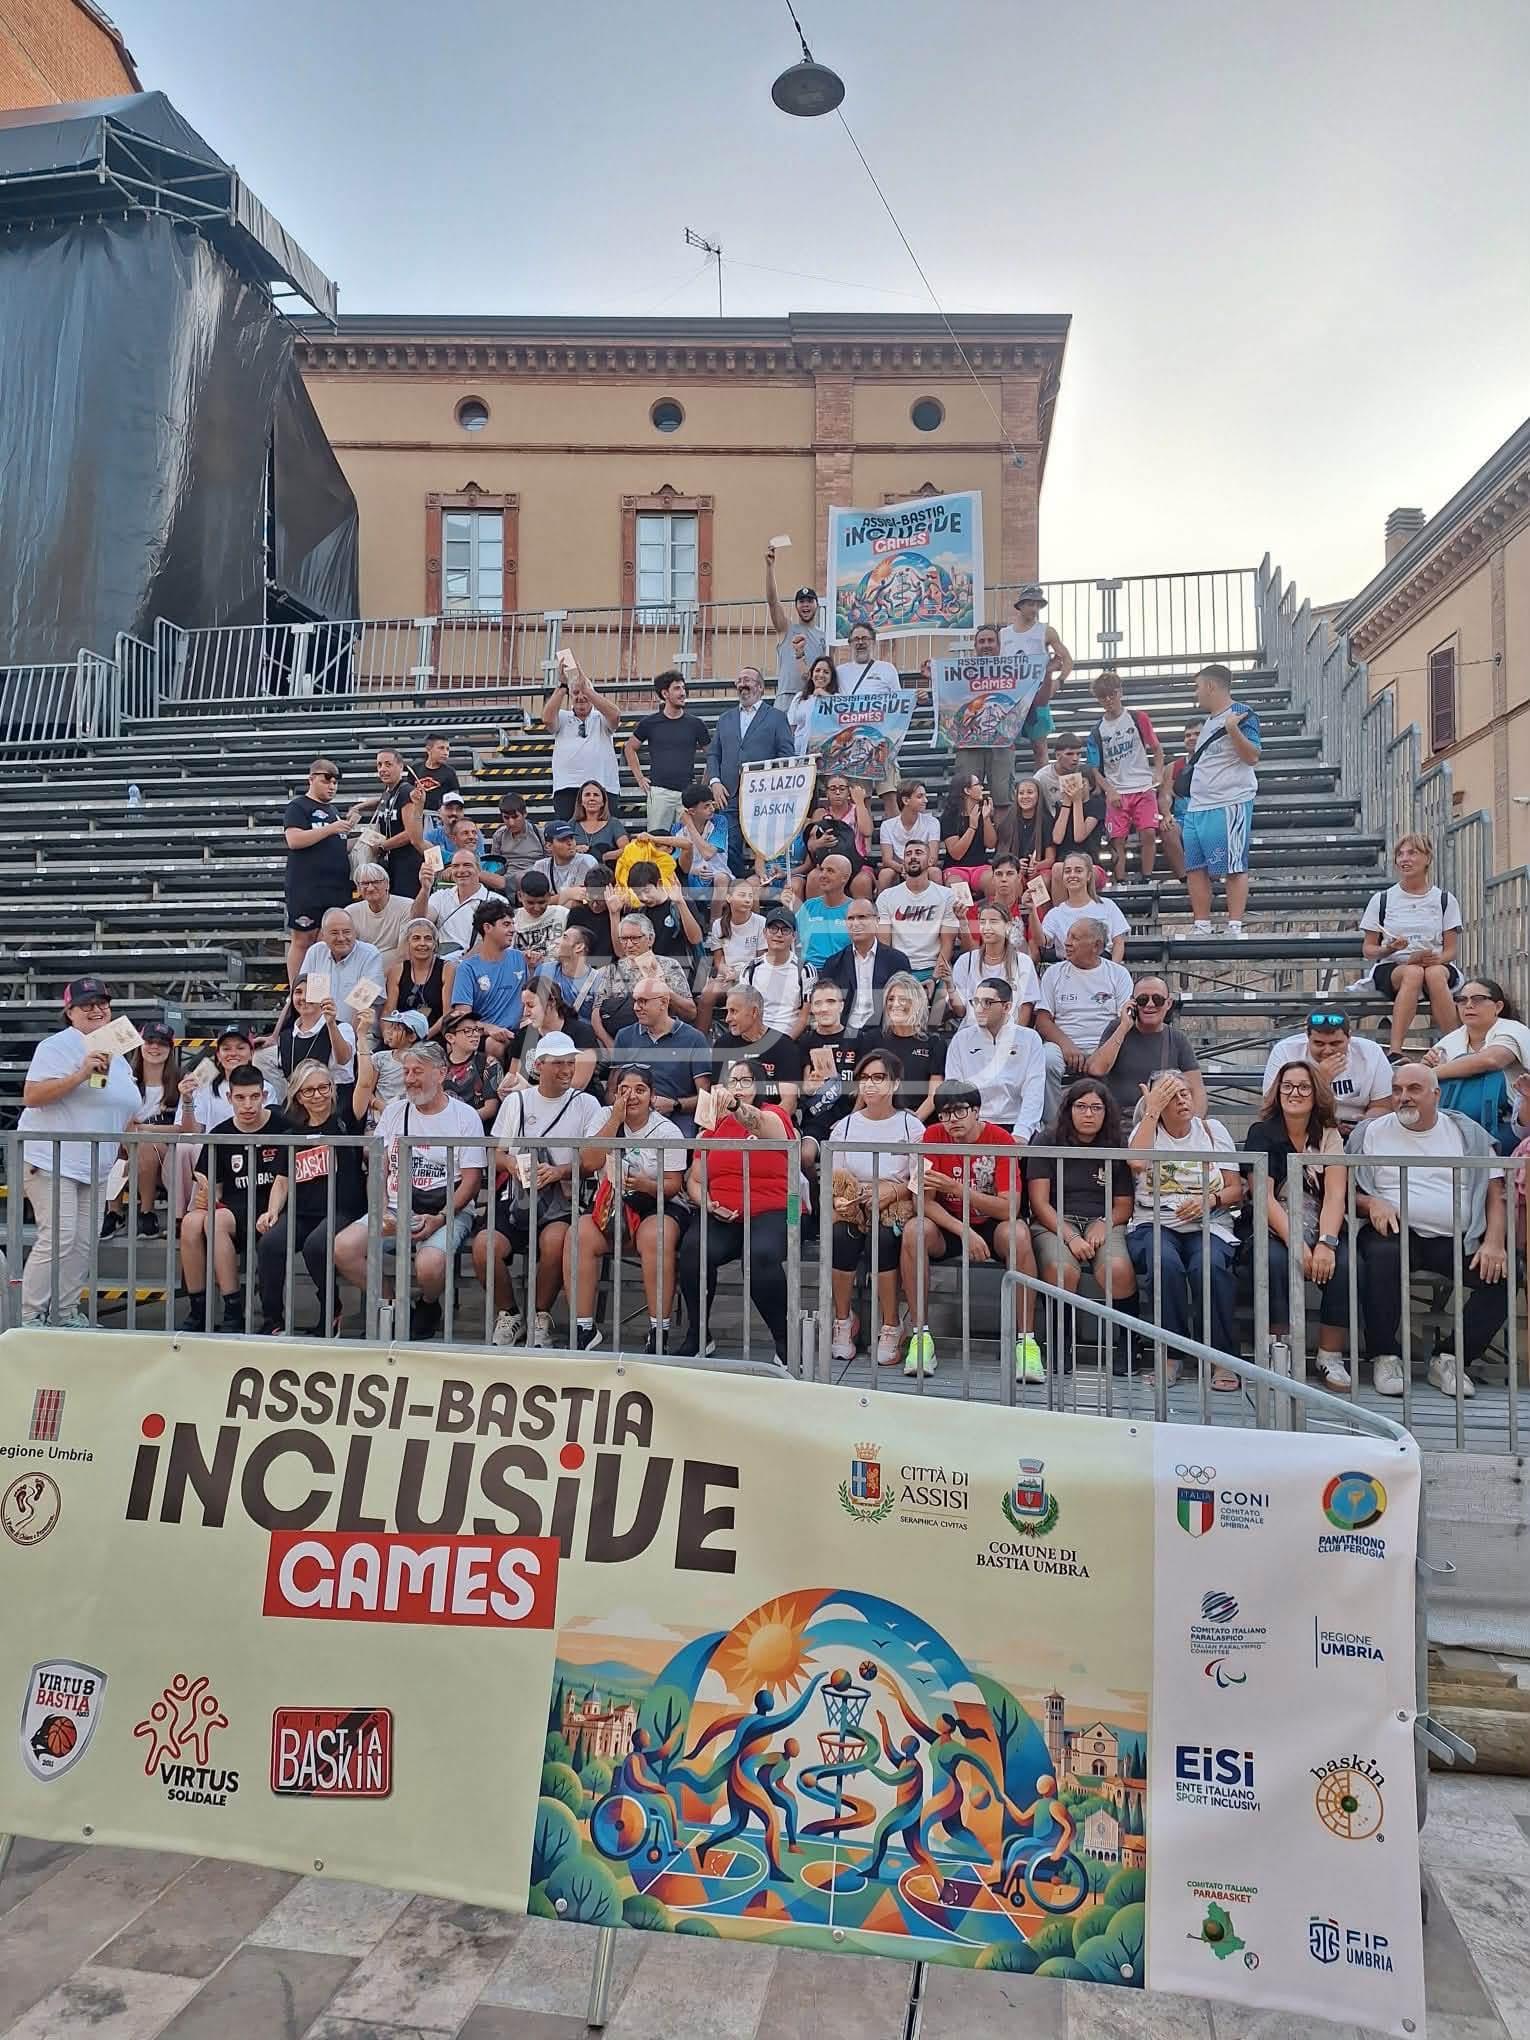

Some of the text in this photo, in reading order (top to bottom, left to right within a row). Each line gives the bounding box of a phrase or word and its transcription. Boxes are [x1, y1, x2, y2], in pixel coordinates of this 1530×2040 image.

[862, 505, 945, 528] ASSISI-BASTIA
[874, 532, 927, 554] GAMES
[958, 655, 1029, 666] ASSISI-BASTIA
[971, 679, 1014, 691] GAMES
[840, 711, 882, 723] GAMES
[749, 774, 806, 793] S.S. LAZIO
[753, 801, 796, 817] BASKIN
[900, 904, 939, 921] NIKE
[516, 921, 563, 948] NETS
[225, 1367, 655, 1448] ASSISI-BASTIA
[0, 1444, 94, 1462] egione Umbria
[900, 1465, 969, 1487] CITTÀ DI
[900, 1485, 969, 1510] ASSISI
[1180, 1489, 1212, 1501] ITALIA
[1220, 1490, 1269, 1508] CONI
[1220, 1507, 1261, 1517] COMITATO
[1220, 1514, 1264, 1525] REGIONALE
[900, 1515, 968, 1531] SERAPHICA CIVITAS
[1220, 1522, 1250, 1531] UMBRIA
[988, 1540, 1077, 1562] COMUNE DI
[1318, 1544, 1385, 1560] CLUB PERUGIA
[976, 1553, 1091, 1578] BASTIA UMBRA
[278, 1541, 541, 1621] GAMES
[1190, 1625, 1267, 1635] COMITATO ITALIANO
[1320, 1631, 1373, 1646] REGIONE
[1320, 1642, 1385, 1662] UMBRIA
[35, 1689, 90, 1712] BASTIA
[160, 1763, 239, 1793] VIRTUS
[1310, 1754, 1386, 1789] baskin
[167, 1789, 227, 1806] SOLIDALE
[1176, 1781, 1256, 1801] ENTE ITALIANO
[1176, 1791, 1261, 1812] SPORT INCLUSIVI
[1186, 1880, 1258, 1894] COMITATO ITALIANO
[1193, 1888, 1252, 1903] PARABASKET
[1346, 1929, 1389, 1950] FIP
[1346, 1947, 1394, 1973] UMBRIA
